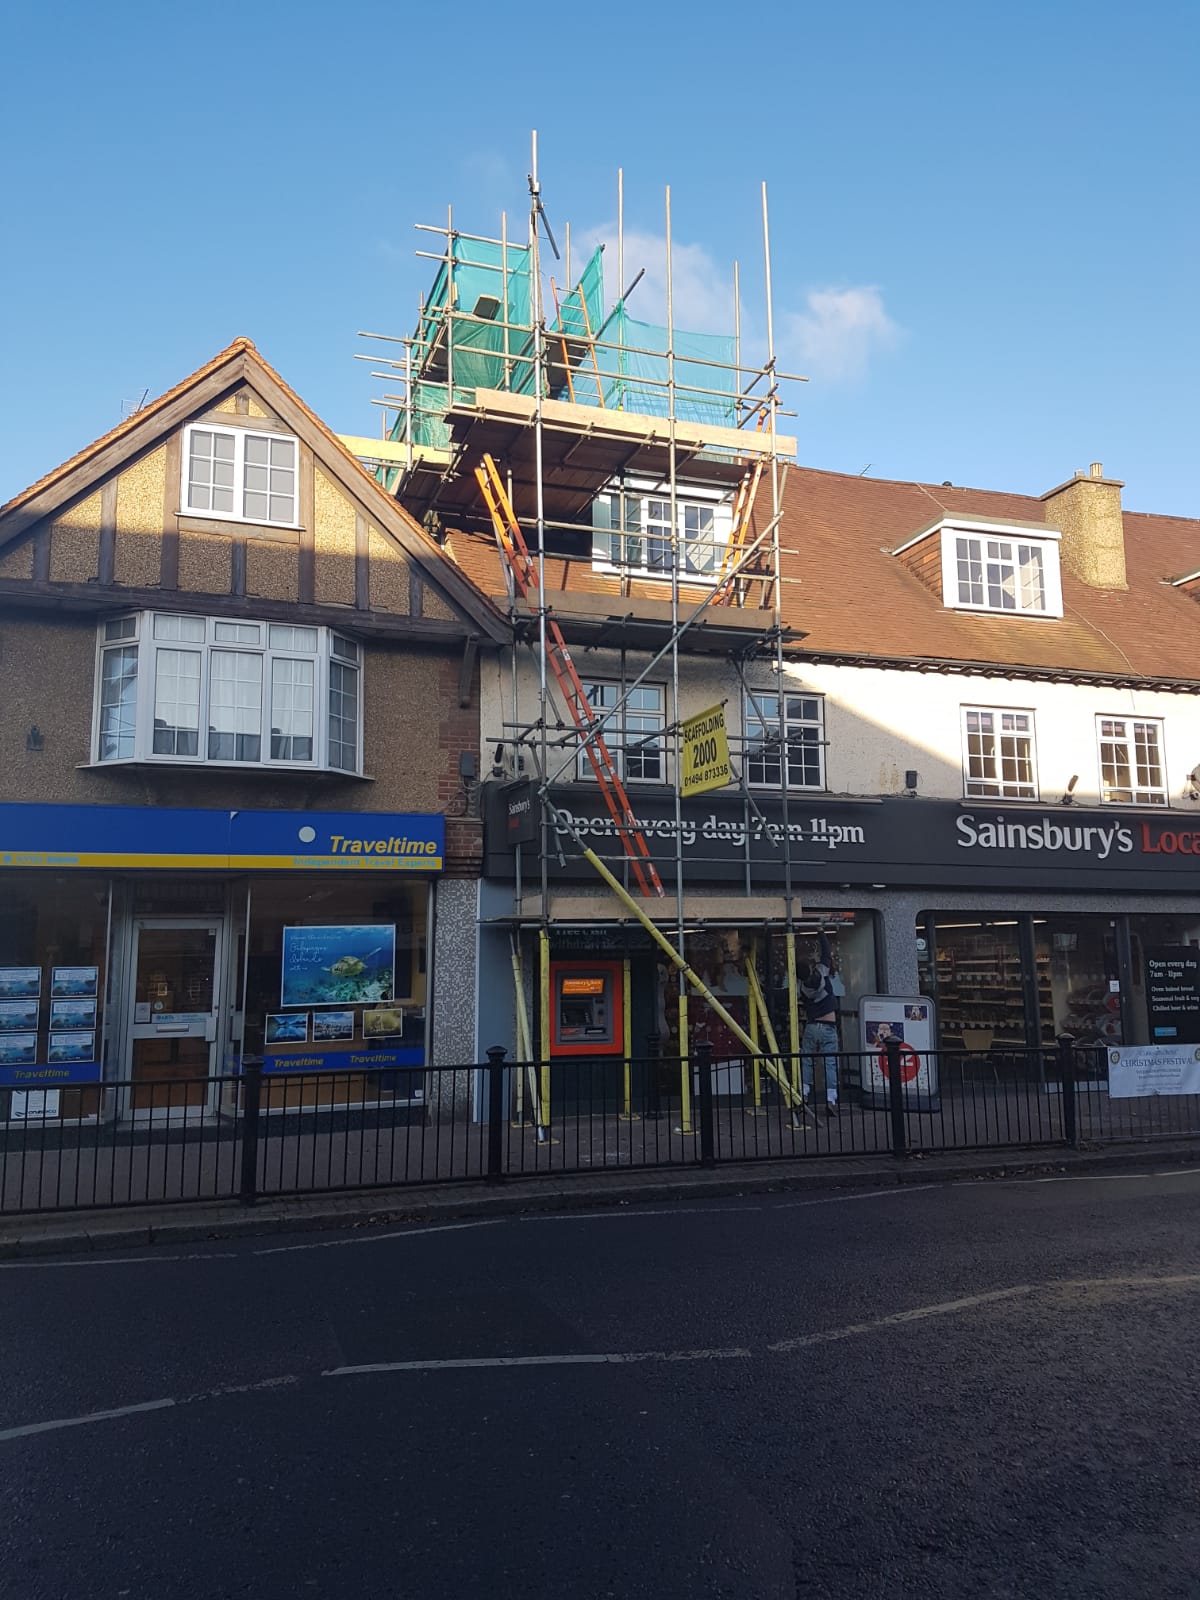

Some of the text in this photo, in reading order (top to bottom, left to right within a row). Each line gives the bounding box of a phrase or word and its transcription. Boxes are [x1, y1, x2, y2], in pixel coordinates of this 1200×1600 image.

[684, 713, 724, 743] SCAFFOLDING
[693, 737, 717, 768] 2000
[684, 773, 703, 787] 01494
[552, 808, 622, 842] Open
[702, 814, 749, 846] day
[810, 818, 865, 849] 11pm
[956, 814, 1133, 859] Sainsbury's
[330, 835, 437, 855] Traveltime
[294, 856, 360, 868] Independent
[1149, 960, 1197, 969] Open every day
[274, 1057, 324, 1068] Traveltime
[350, 1053, 396, 1064] Traveltime
[15, 1069, 70, 1079] Traveltime
